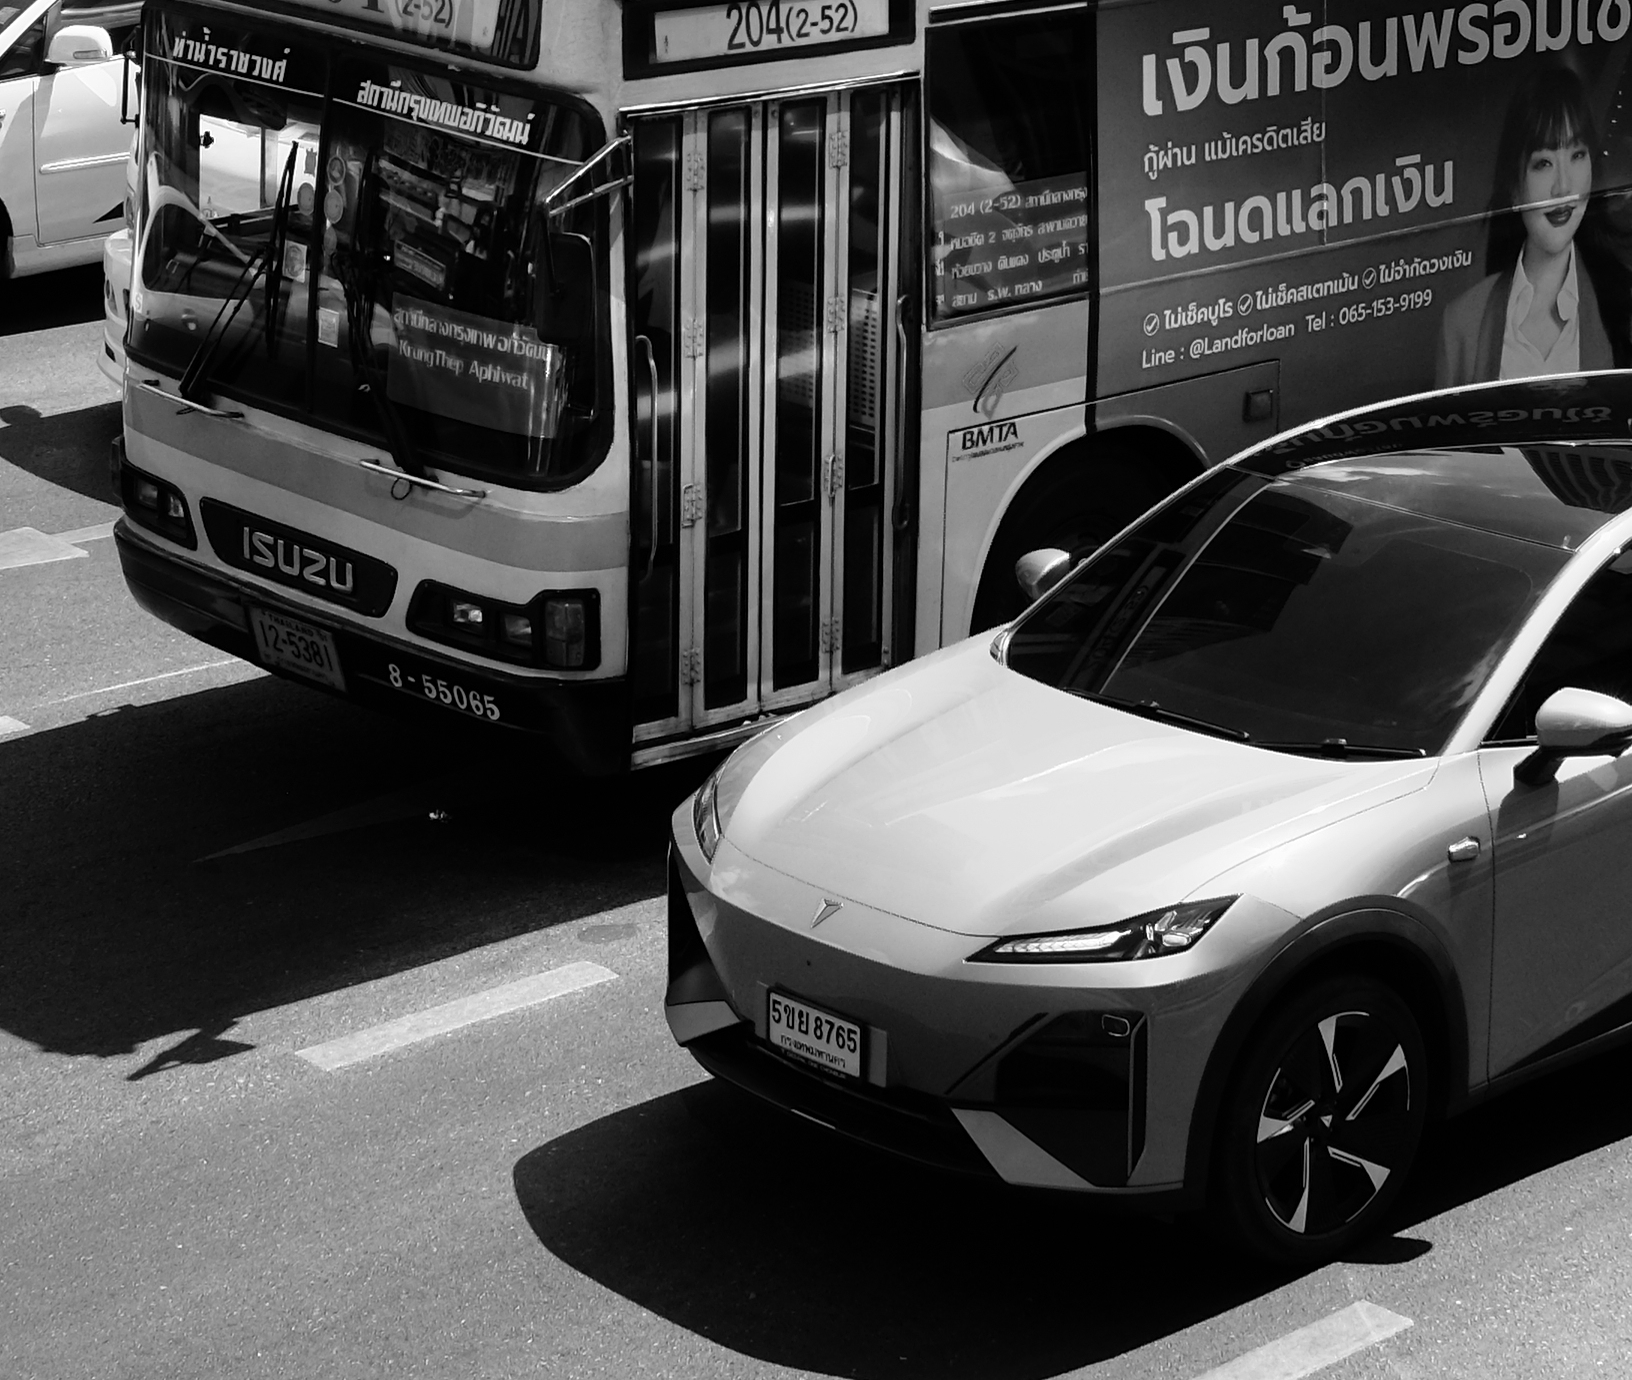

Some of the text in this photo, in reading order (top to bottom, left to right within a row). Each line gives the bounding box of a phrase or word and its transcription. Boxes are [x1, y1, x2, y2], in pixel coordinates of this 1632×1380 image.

[172, 26, 291, 83] ท่าน้ำราชวงศ์
[1143, 117, 1327, 182] กู้ผ่าน แม้เครดิตเสีย
[951, 201, 976, 220] 204
[980, 194, 1023, 214] (2-52)
[1144, 153, 1455, 263] โฉนดแลกเงิน
[988, 230, 997, 245] 2
[1015, 280, 1043, 296] กลาง
[1164, 297, 1234, 330] ไม่เช็คบูโร
[1379, 249, 1473, 285] ไม่จำกัดวงเงิน
[1142, 348, 1175, 369] Line
[1189, 321, 1295, 359] @Landforloan
[1305, 313, 1326, 334] Tel
[1338, 288, 1433, 327] 065-153-9199
[468, 359, 529, 391] Aphiwat
[962, 421, 1018, 451] BMTA
[243, 525, 355, 595] ISUZU
[813, 1016, 858, 1054] 8765
